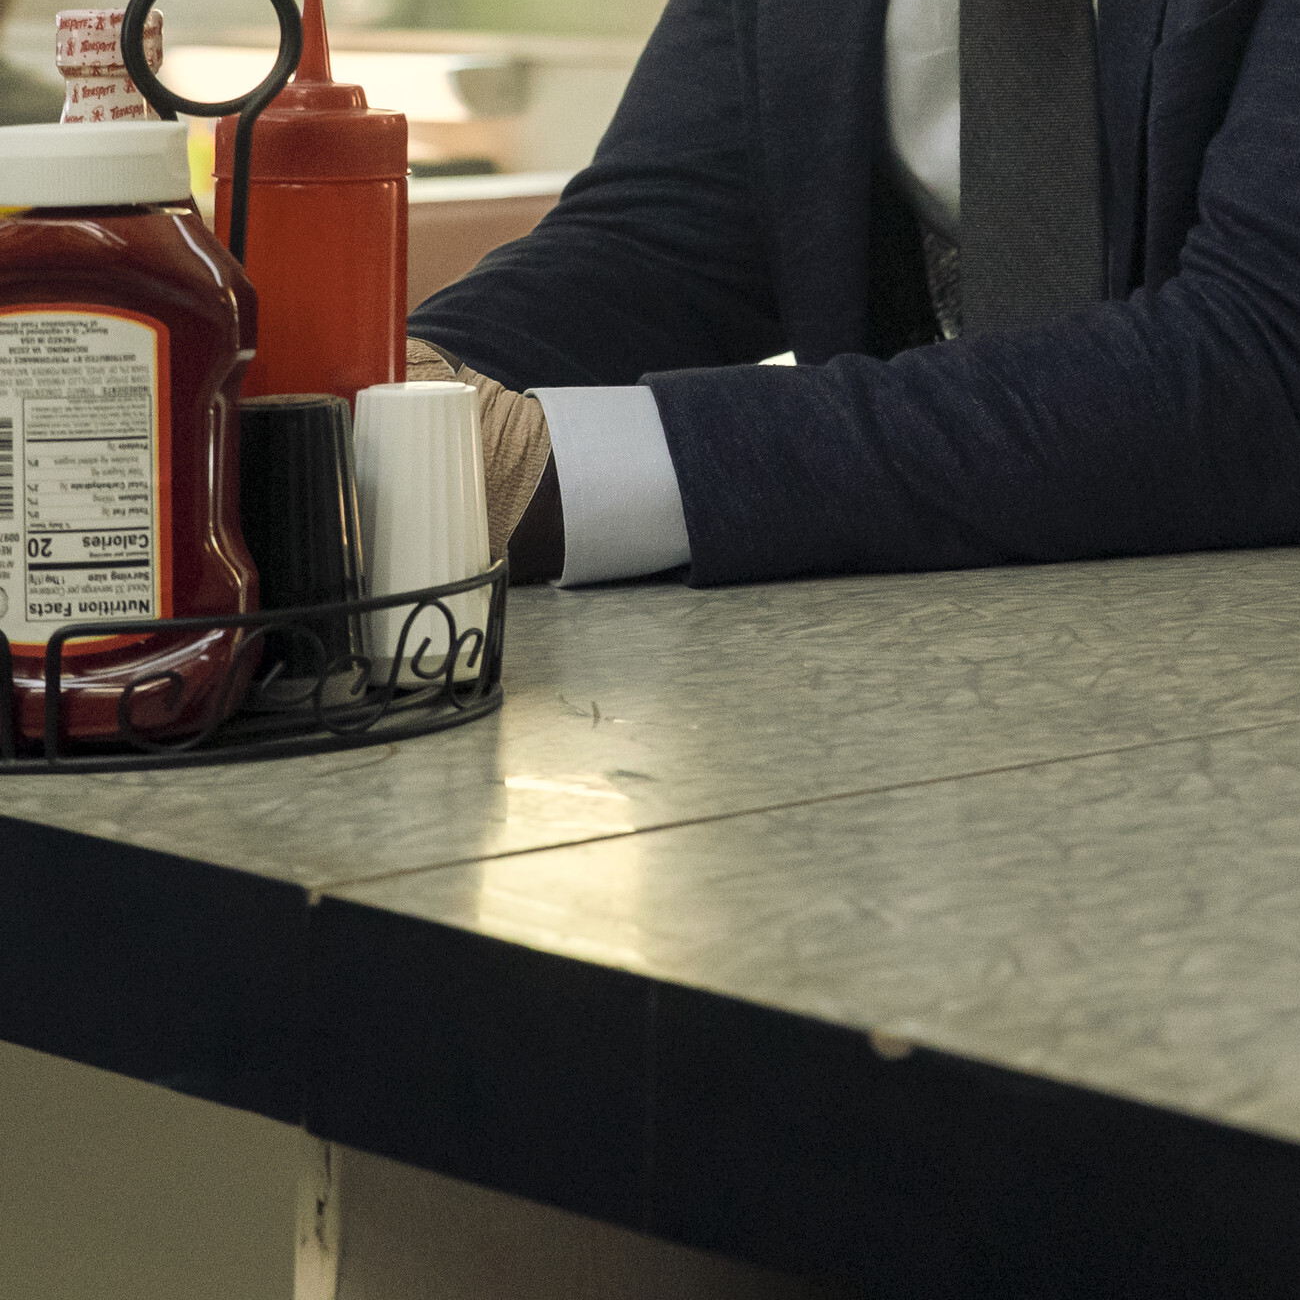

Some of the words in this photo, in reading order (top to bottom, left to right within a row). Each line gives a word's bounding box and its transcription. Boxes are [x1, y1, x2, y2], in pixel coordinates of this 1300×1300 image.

[27, 537, 53, 558] 20
[81, 534, 150, 551] Calories
[87, 572, 108, 582] size
[111, 571, 150, 582] Serving
[29, 602, 72, 617] Facts
[78, 599, 150, 616] Nutrition
